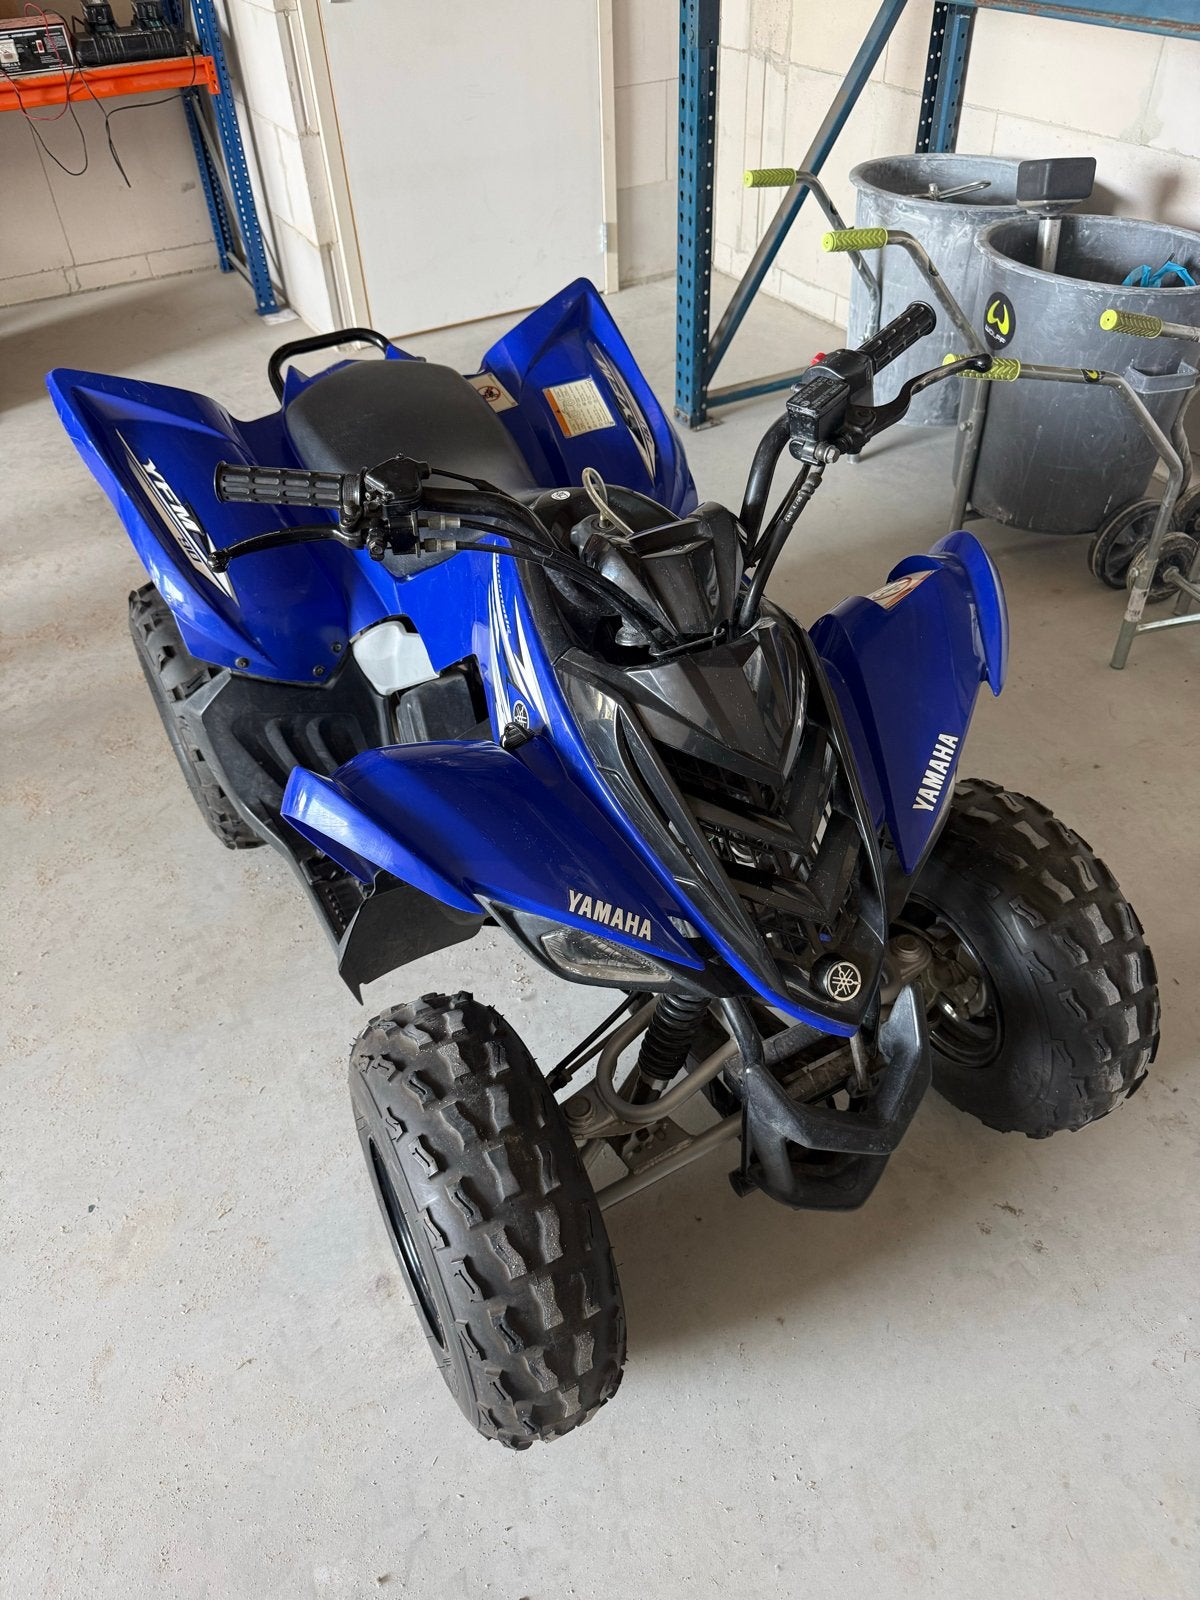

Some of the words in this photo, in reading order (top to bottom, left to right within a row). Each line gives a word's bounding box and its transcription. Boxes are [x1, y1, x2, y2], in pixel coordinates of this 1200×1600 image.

[142, 458, 206, 537] YFM
[177, 537, 202, 563] 90
[911, 733, 959, 812] YAMAHA
[568, 889, 652, 941] YAMAHA
